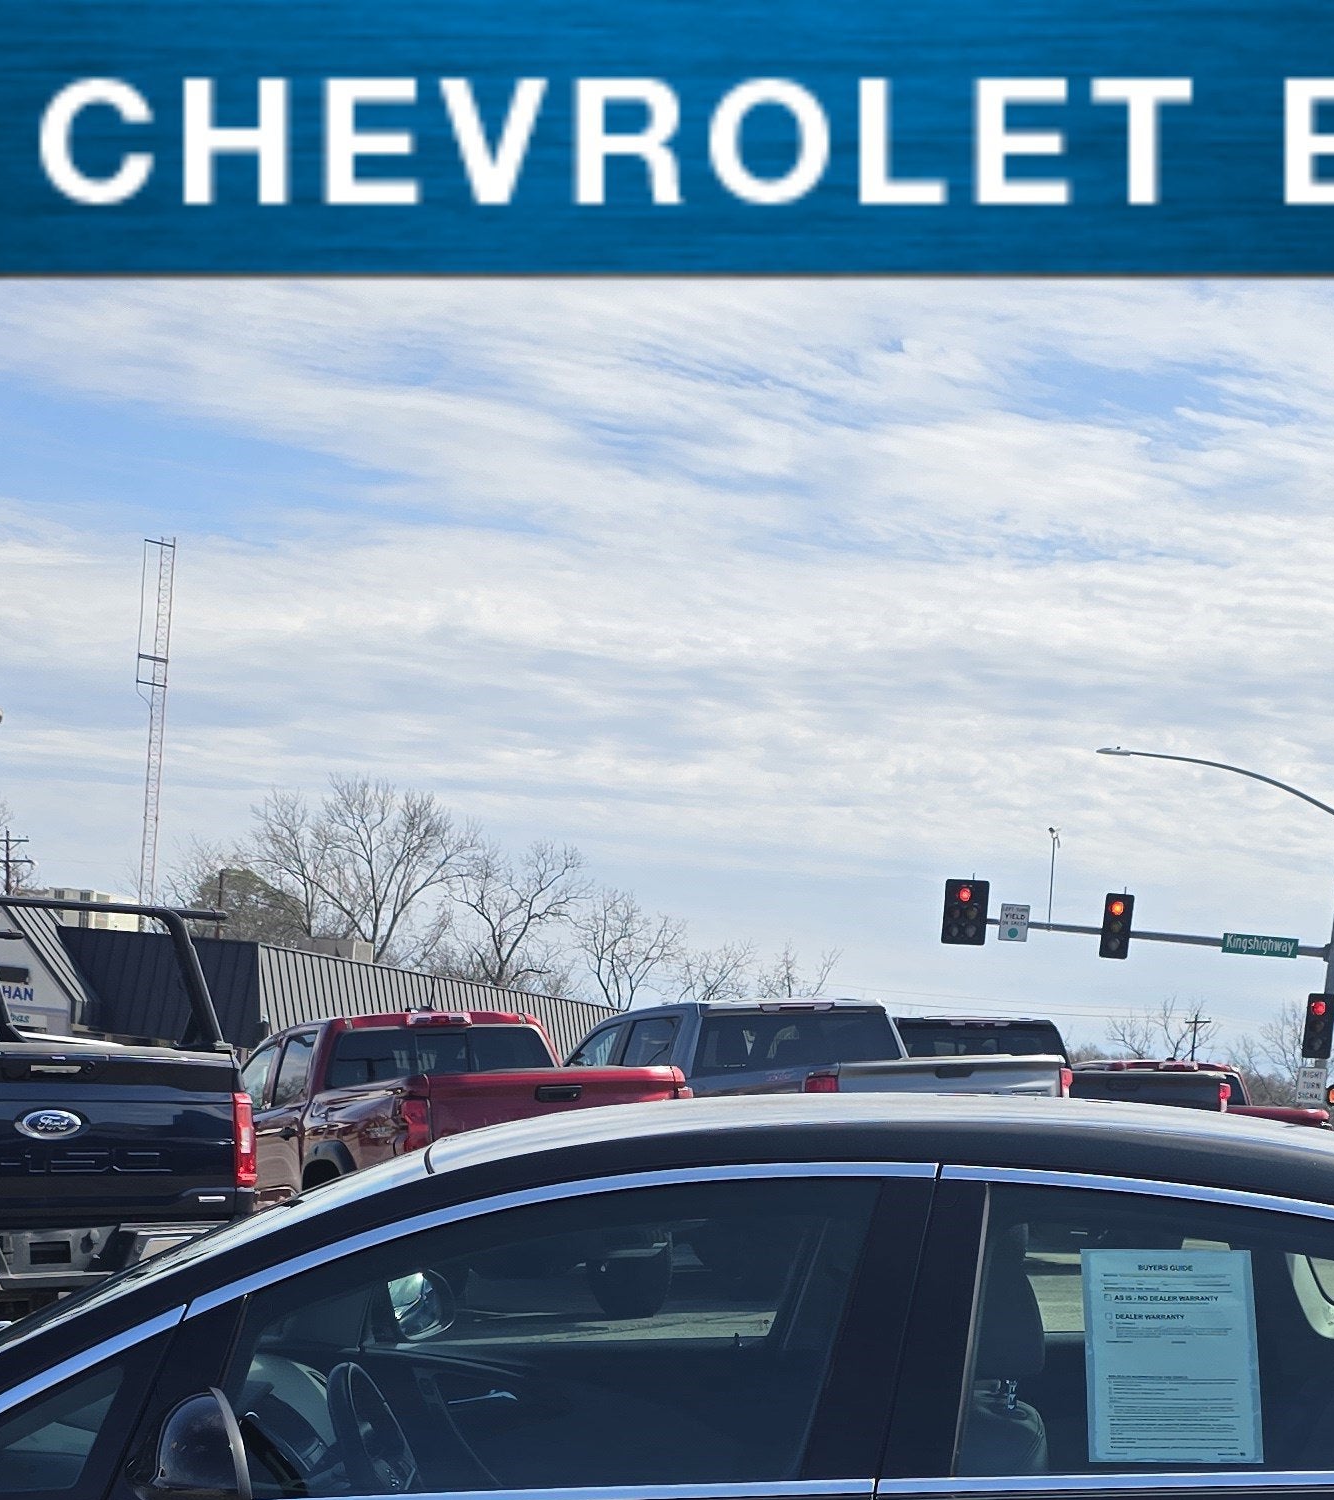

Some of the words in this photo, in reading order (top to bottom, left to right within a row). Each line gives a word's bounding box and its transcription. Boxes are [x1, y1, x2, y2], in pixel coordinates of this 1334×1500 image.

[1004, 912, 1026, 920] YIELD
[1226, 934, 1295, 956] Kingshighway
[35, 1115, 71, 1132] Ford
